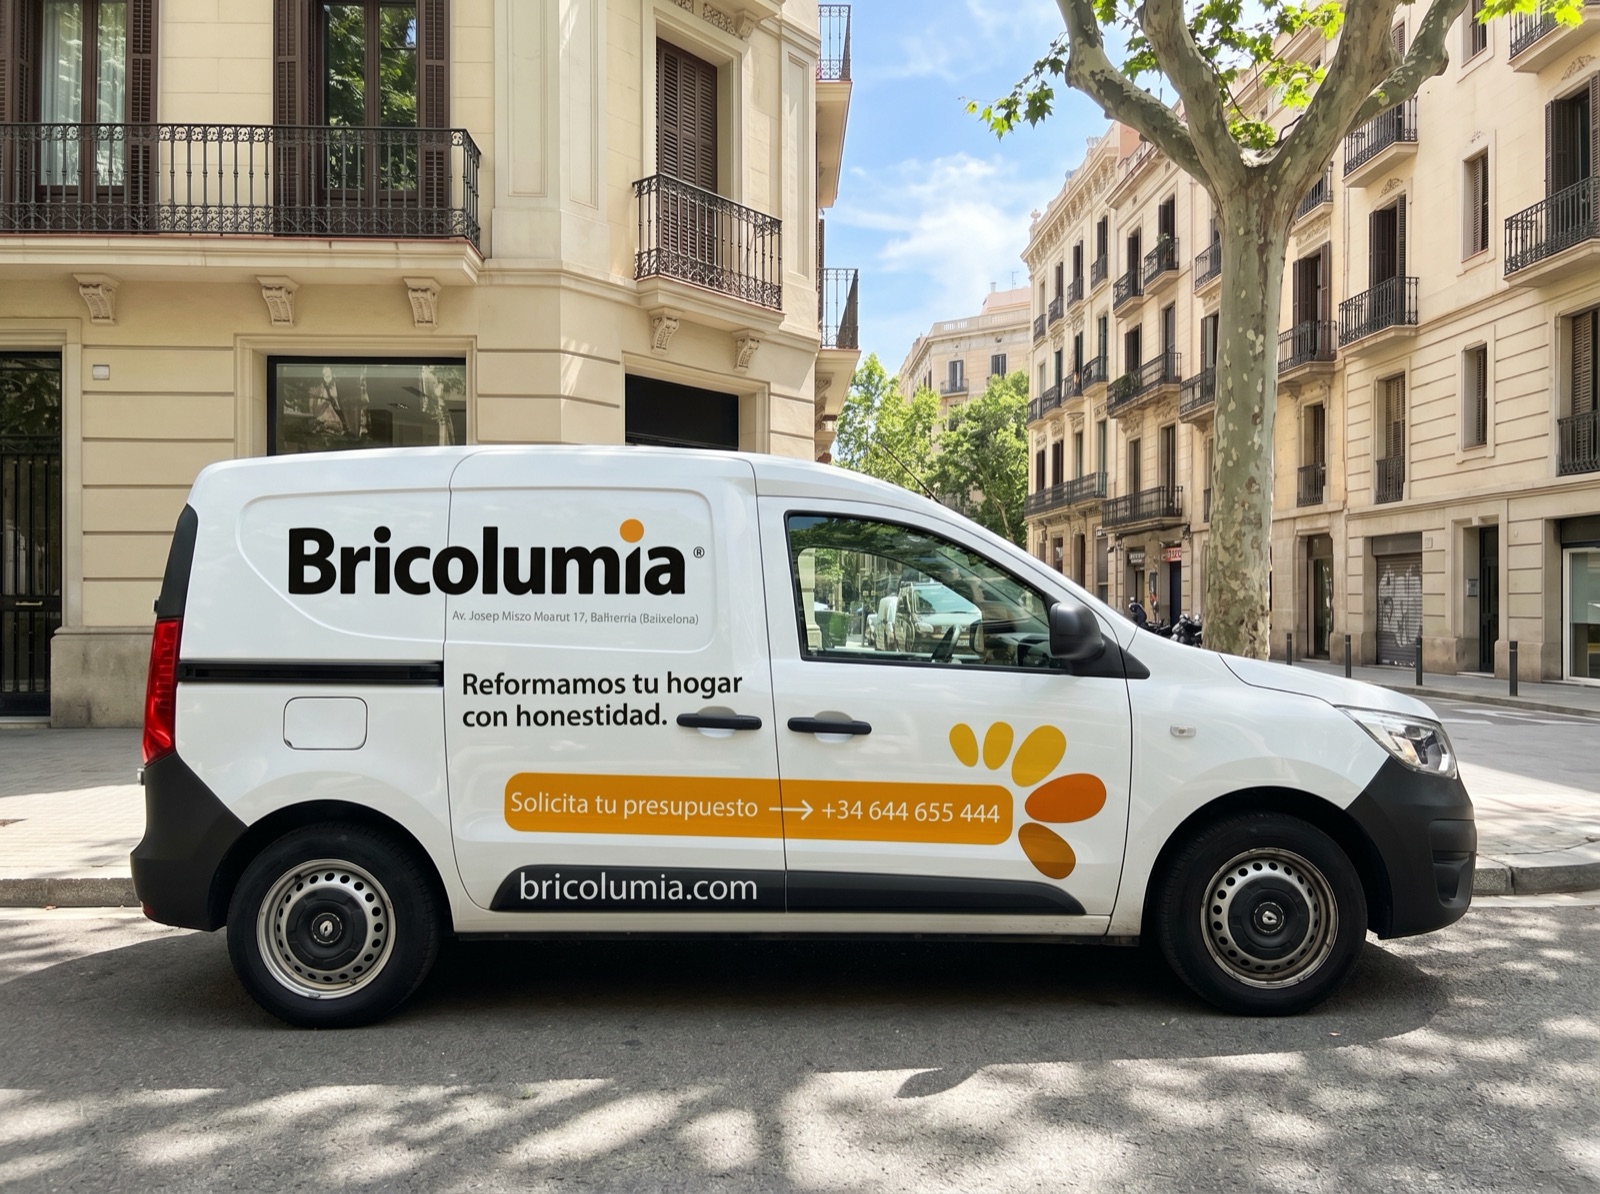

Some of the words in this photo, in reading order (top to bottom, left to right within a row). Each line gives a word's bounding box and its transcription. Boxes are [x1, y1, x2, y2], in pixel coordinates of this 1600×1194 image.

[289, 519, 686, 595] Bricolumia
[453, 611, 466, 620] Av.
[469, 611, 499, 623] Josep
[463, 672, 626, 695] Reformamos
[632, 674, 658, 694] tu
[667, 671, 742, 699] hogar
[463, 711, 507, 727] con
[517, 702, 667, 727] honestidad.
[511, 792, 588, 813] Solicita
[595, 796, 616, 814] tu
[624, 799, 758, 820] presupuesto
[822, 800, 863, 819] +34
[869, 801, 908, 820] 644
[915, 803, 953, 822] 655
[960, 804, 1000, 823] 444
[521, 872, 758, 901] bricolumia.com
